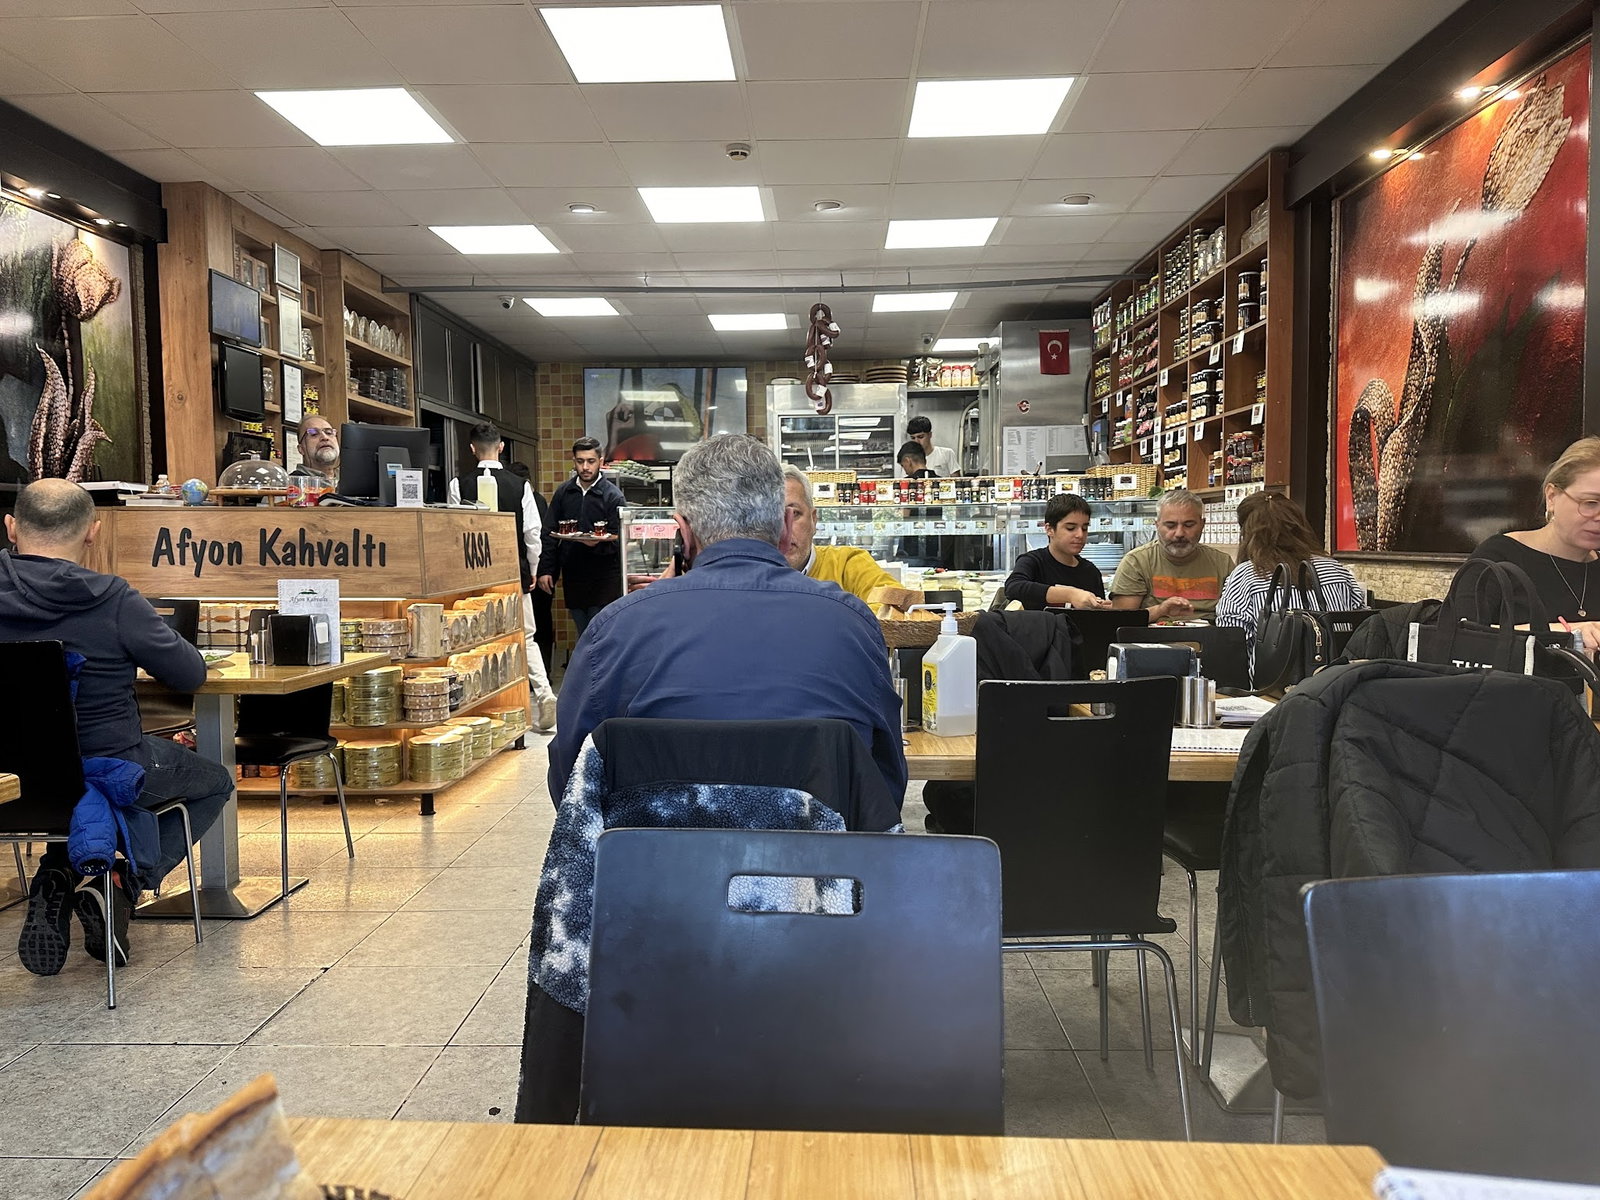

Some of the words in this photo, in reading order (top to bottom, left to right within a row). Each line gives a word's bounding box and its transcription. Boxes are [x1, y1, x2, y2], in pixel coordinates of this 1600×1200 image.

[151, 527, 243, 578] Afyon
[259, 527, 386, 567] Kahvaltı
[462, 532, 492, 570] KASA
